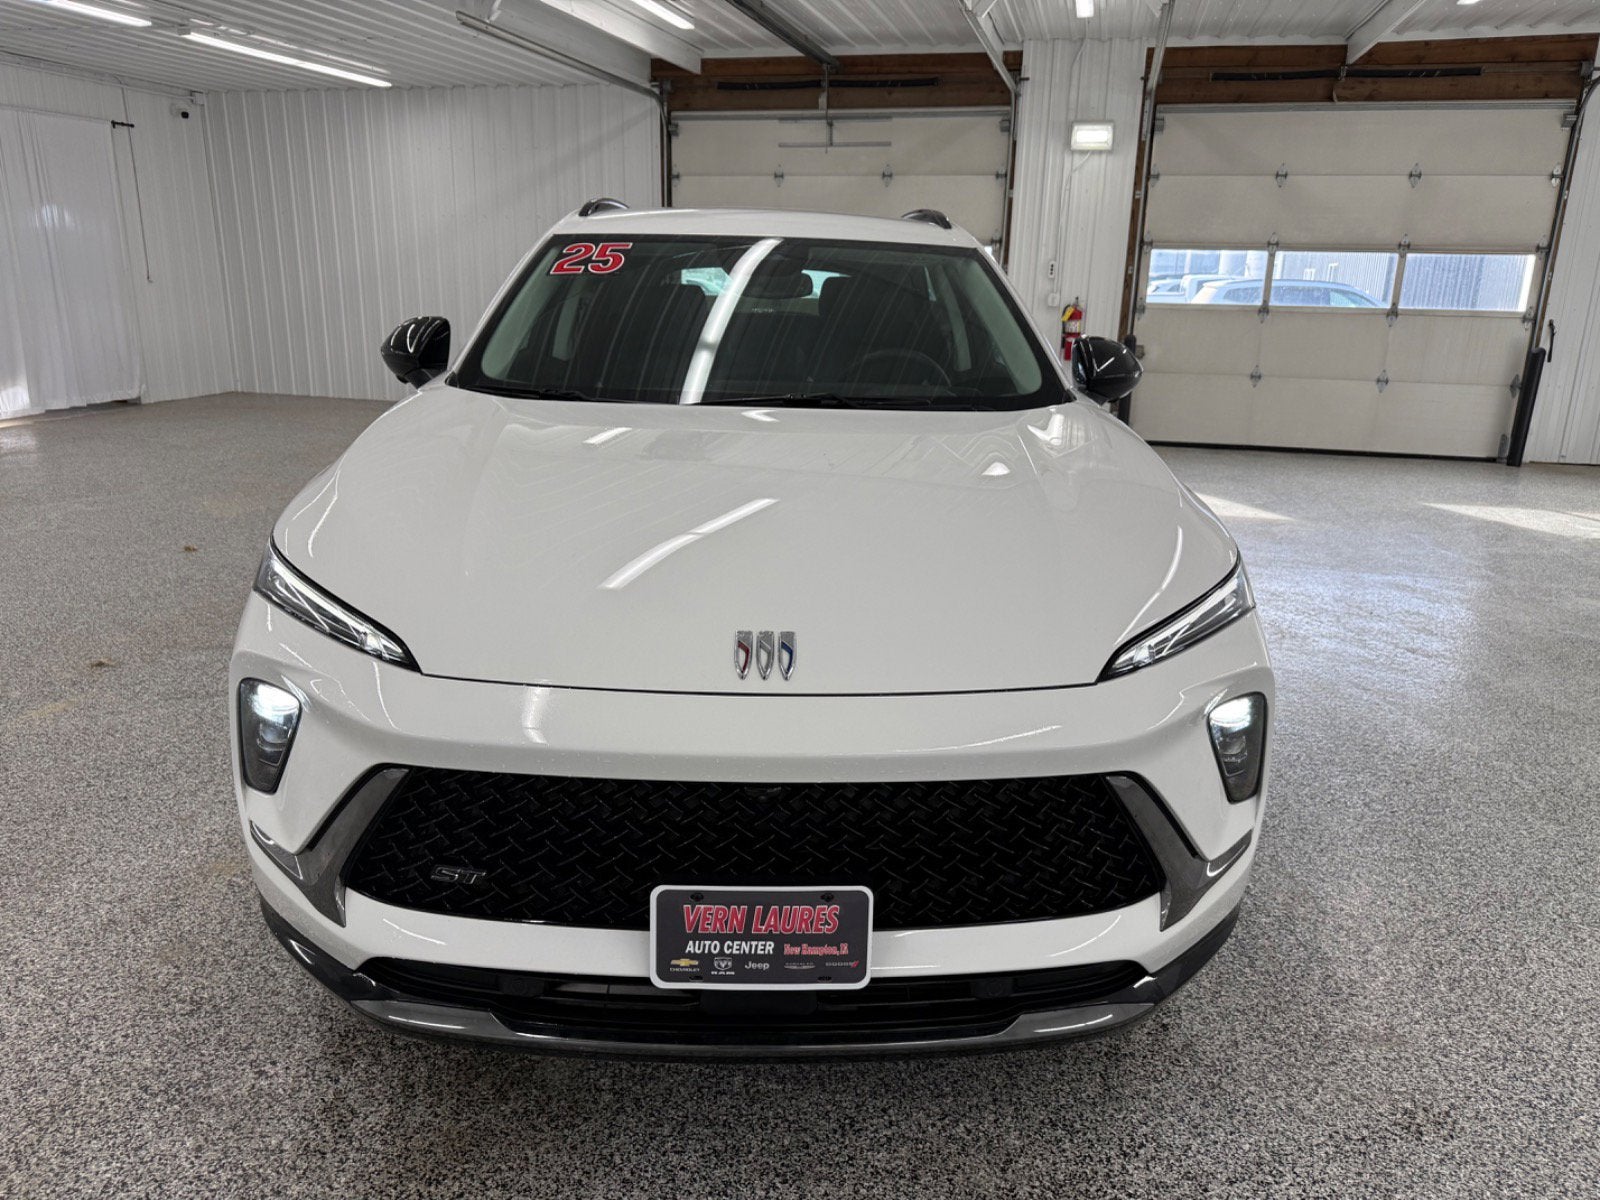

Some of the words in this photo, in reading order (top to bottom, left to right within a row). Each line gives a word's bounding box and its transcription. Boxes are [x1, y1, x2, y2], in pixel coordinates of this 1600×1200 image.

[550, 242, 633, 275] 25
[683, 904, 747, 933] VERN
[752, 904, 840, 934] LAURES
[685, 940, 720, 954] AUTO
[724, 941, 775, 955] CENTER
[783, 943, 800, 955] New
[745, 960, 770, 971] Jeep
